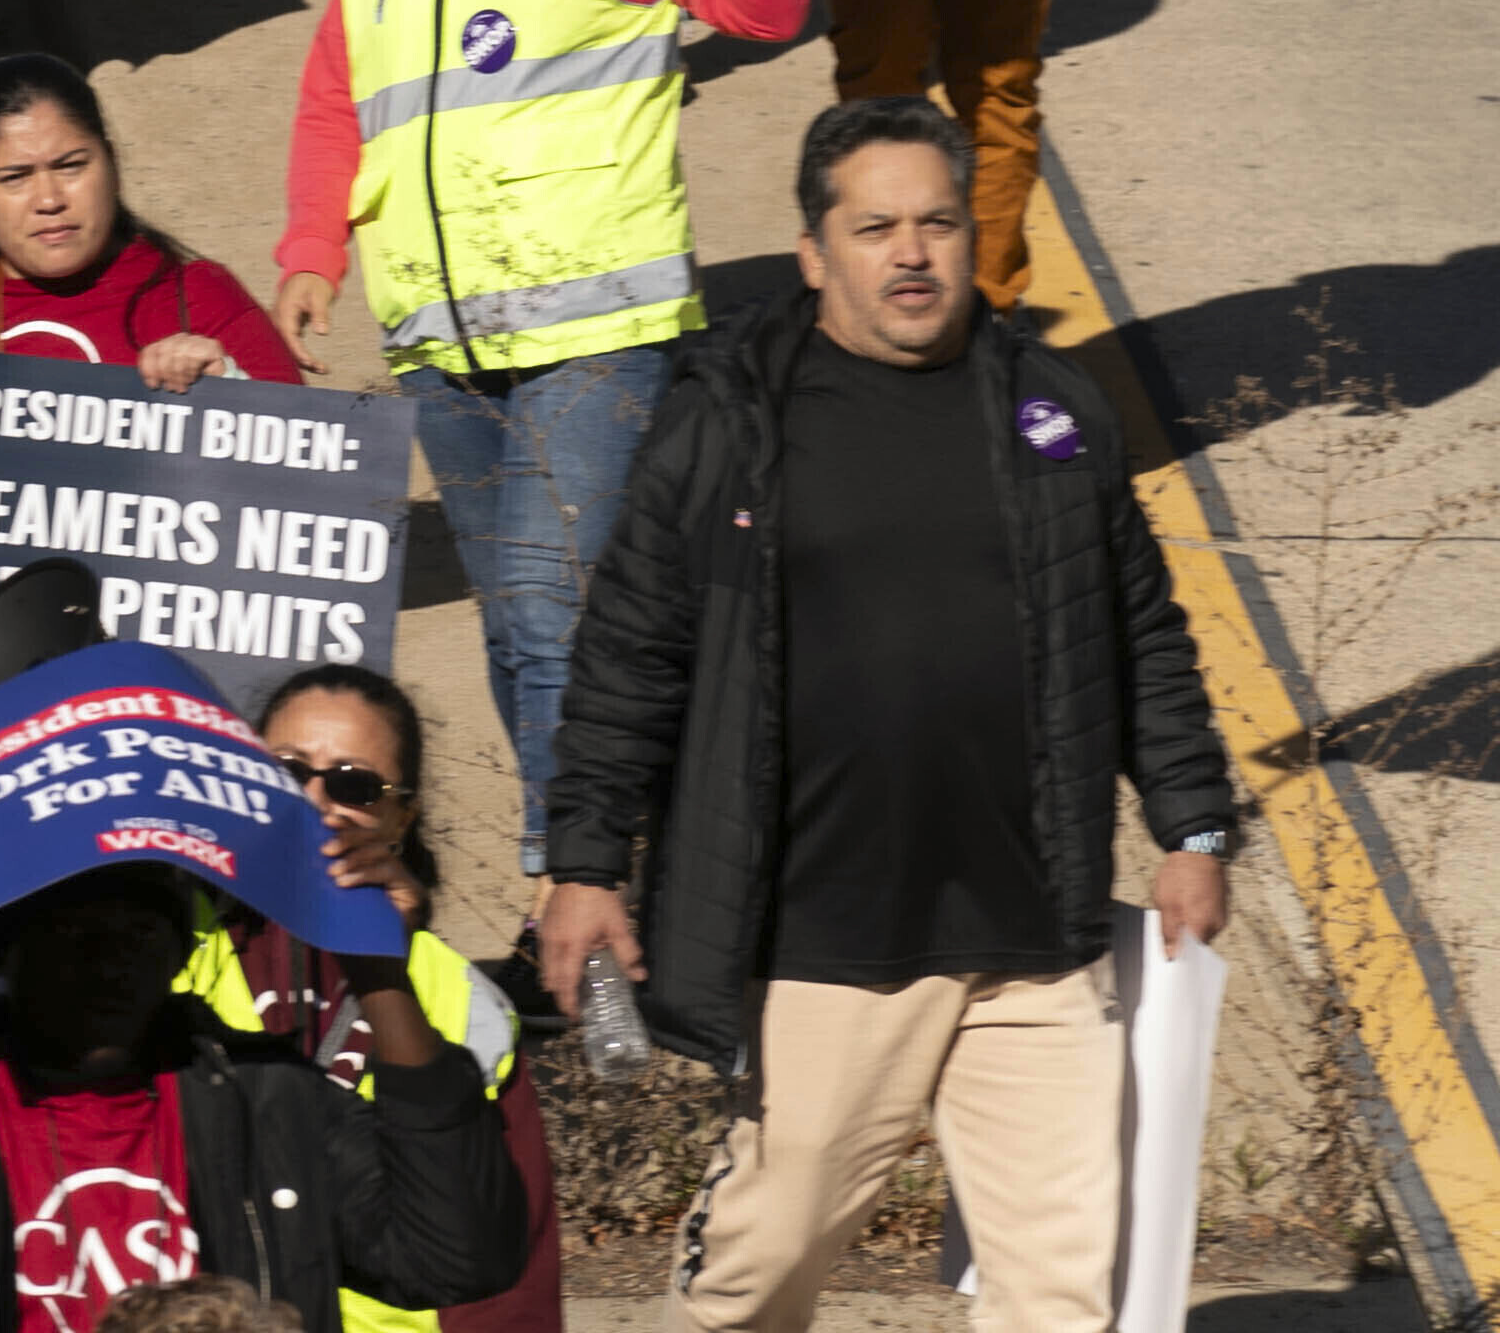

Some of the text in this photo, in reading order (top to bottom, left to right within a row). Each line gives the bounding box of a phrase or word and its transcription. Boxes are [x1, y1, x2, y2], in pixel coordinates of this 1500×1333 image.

[201, 409, 359, 472] BIDEN:
[235, 506, 390, 584] NEED
[24, 769, 273, 825] For All!
[103, 831, 234, 877] WORK
